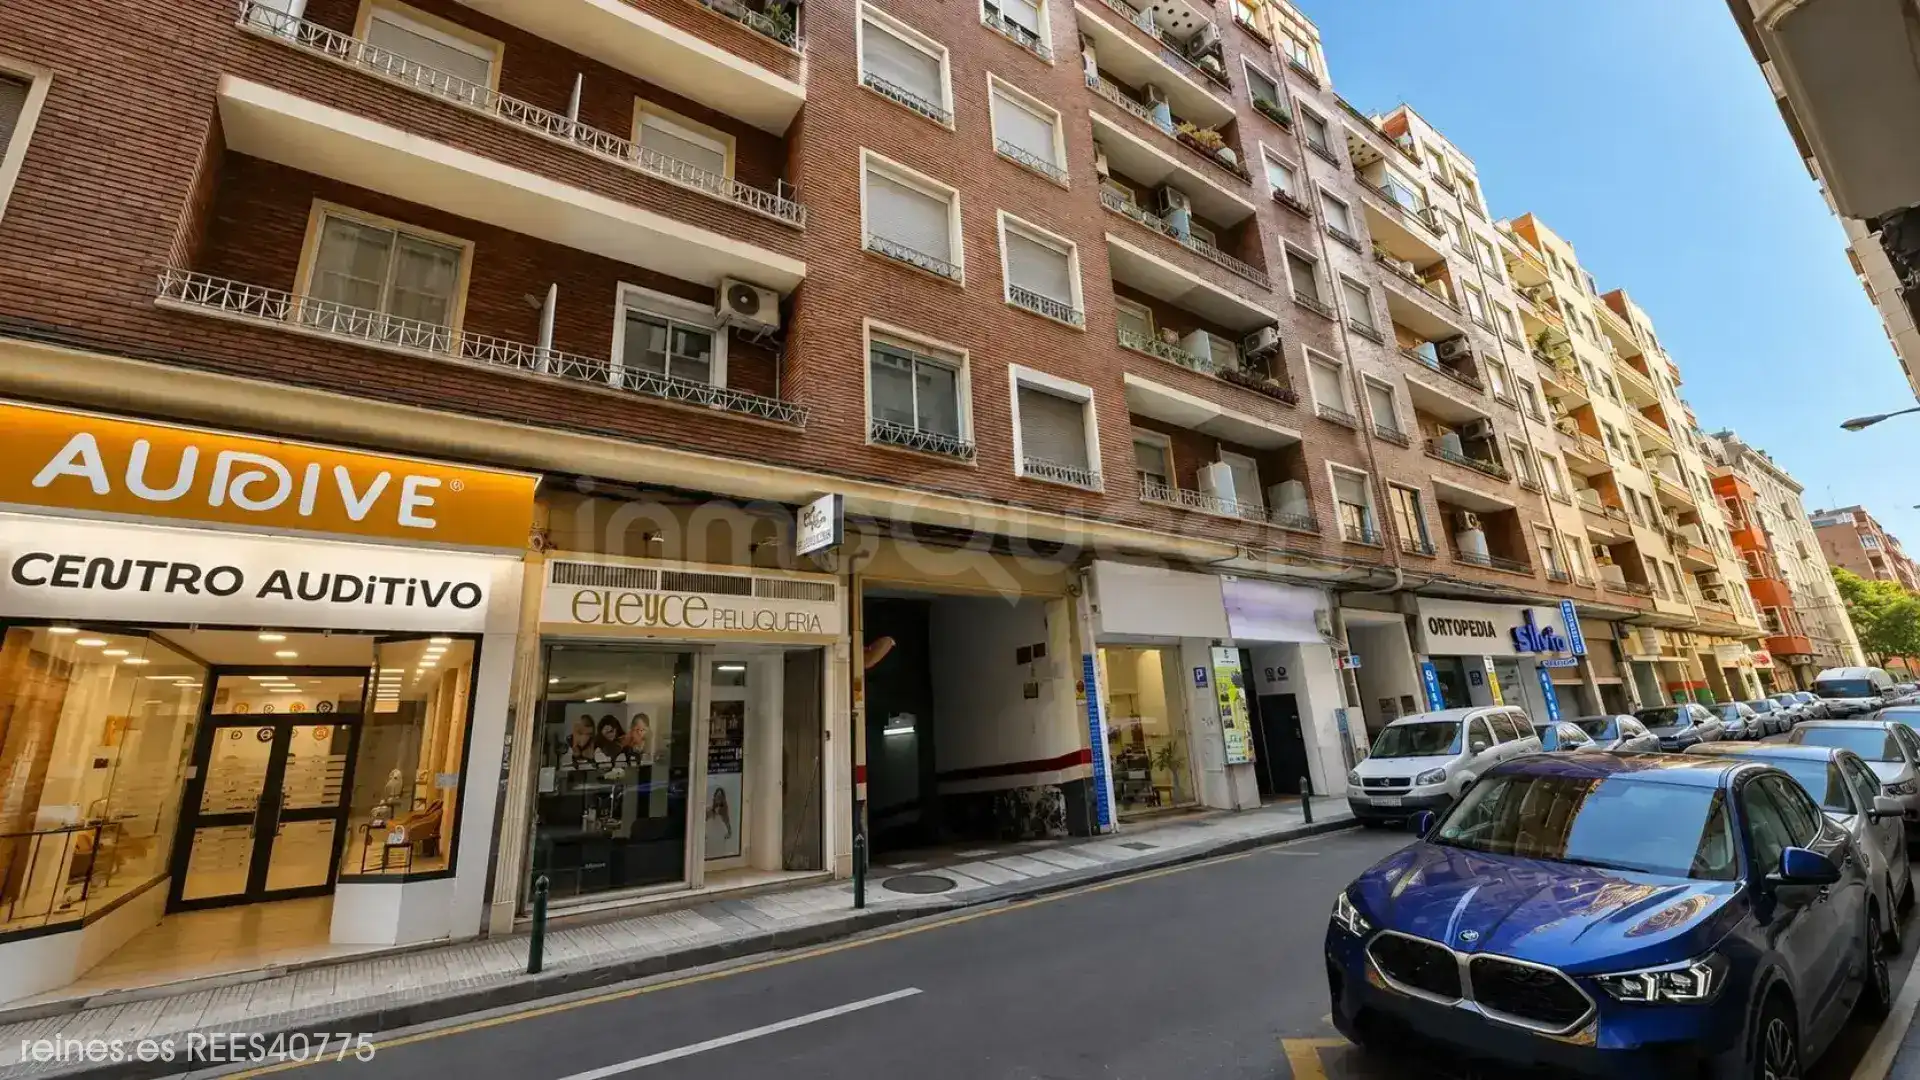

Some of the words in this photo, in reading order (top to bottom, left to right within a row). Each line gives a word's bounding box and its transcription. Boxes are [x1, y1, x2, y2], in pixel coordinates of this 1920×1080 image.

[32, 433, 442, 529] AUDIVE
[12, 552, 244, 597] CENTRO
[1428, 617, 1497, 638] ORTOPEDIA
